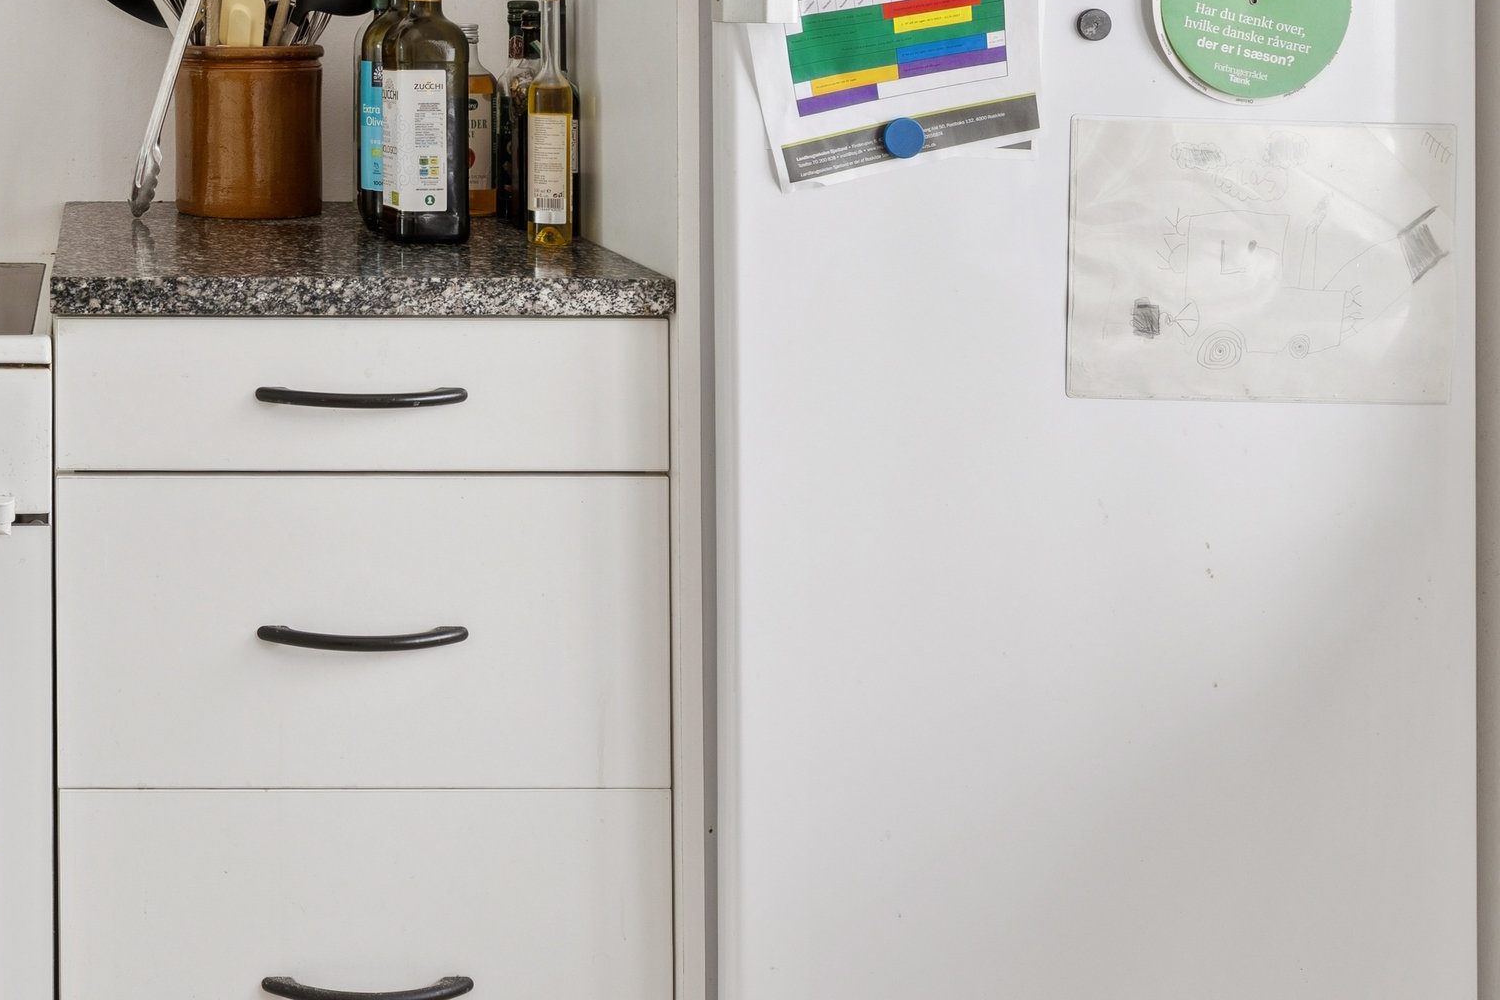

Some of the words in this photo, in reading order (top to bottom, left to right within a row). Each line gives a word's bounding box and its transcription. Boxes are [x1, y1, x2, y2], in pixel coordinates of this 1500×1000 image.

[1195, 2, 1218, 17] Har
[1219, 8, 1235, 21] du
[1238, 12, 1273, 30] tænkt
[1276, 21, 1306, 39] over,
[1184, 16, 1220, 34] hvilke
[1222, 25, 1265, 44] danske
[1267, 35, 1312, 54] råvarer
[1196, 36, 1219, 50] der
[1221, 44, 1235, 55] er
[1243, 49, 1295, 67] sæson?
[1214, 62, 1269, 81] Forbrugerrådet
[1229, 74, 1251, 87] Tænk
[414, 83, 444, 91] ZUCCHI
[362, 103, 381, 114] Extra
